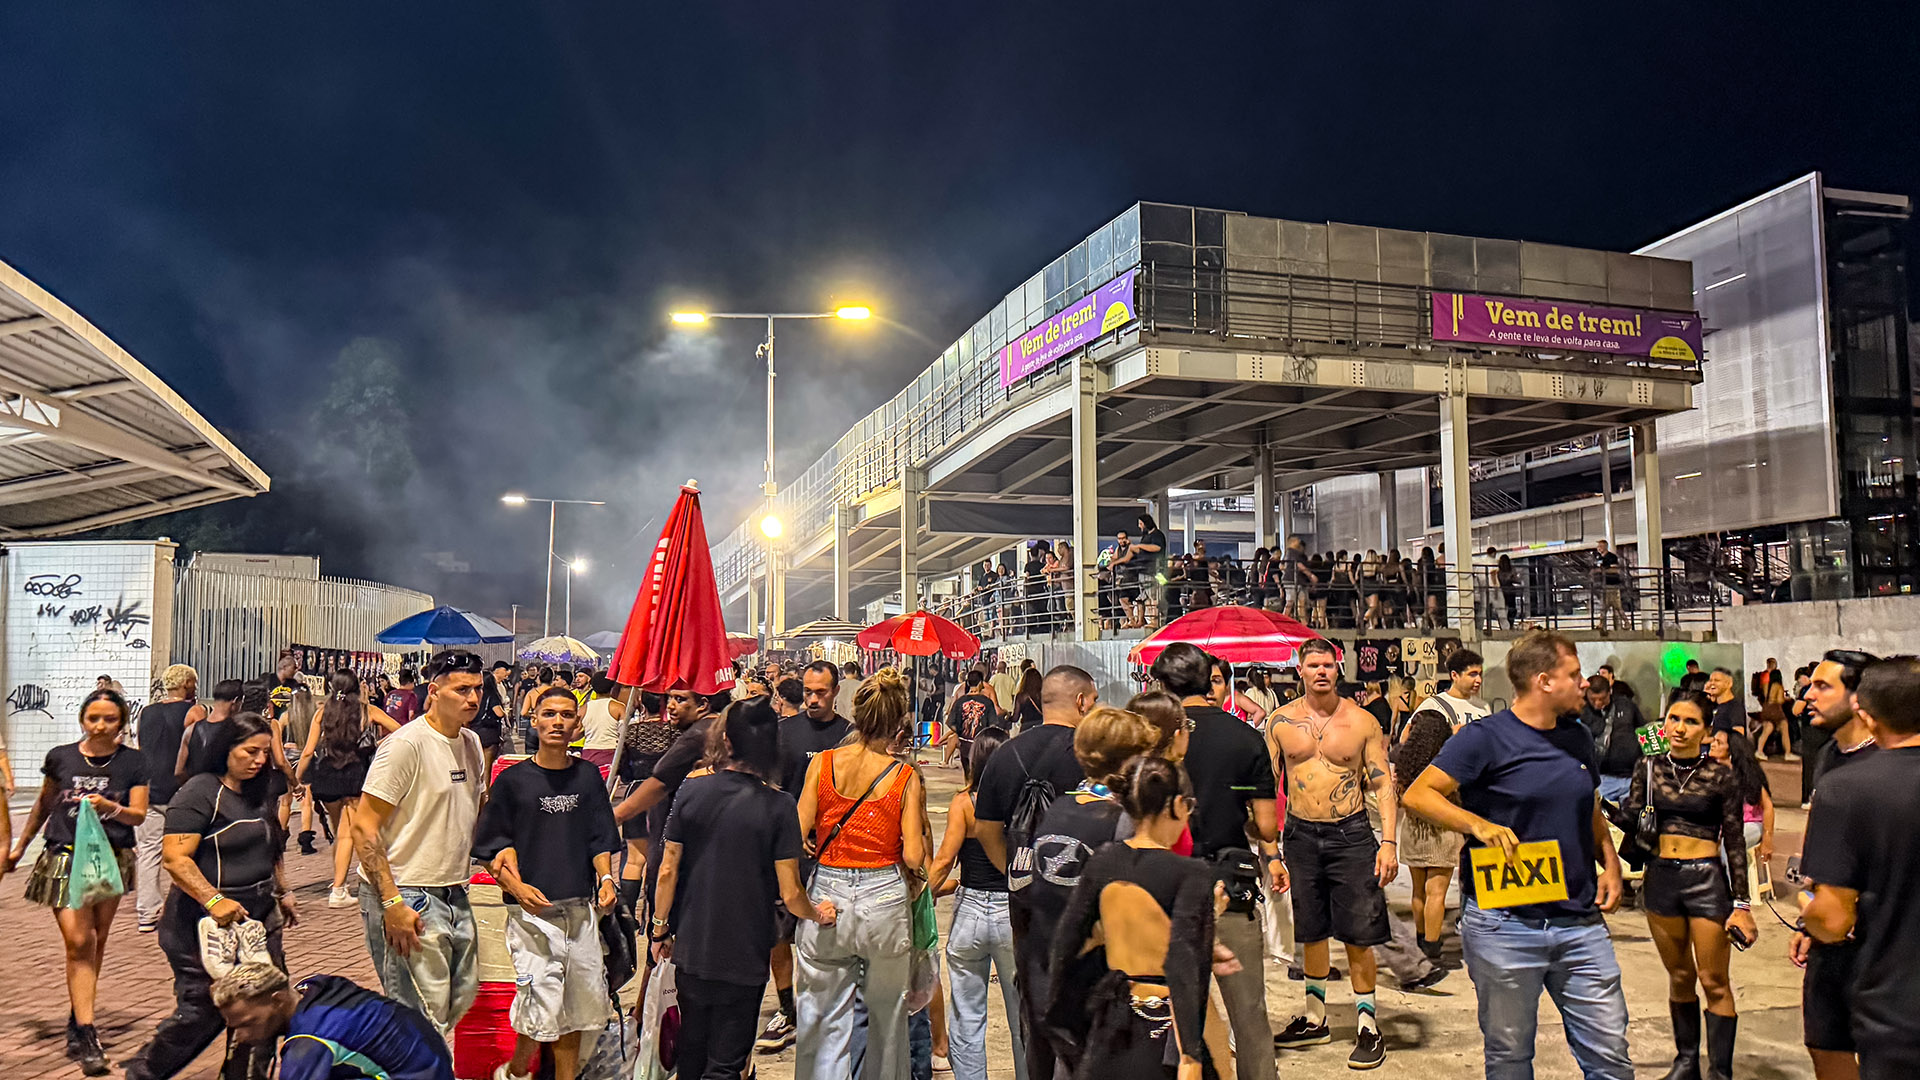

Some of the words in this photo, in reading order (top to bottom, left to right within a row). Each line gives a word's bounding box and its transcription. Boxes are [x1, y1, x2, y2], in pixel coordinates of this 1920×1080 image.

[1020, 333, 1044, 359] Vem
[1045, 320, 1060, 344] de
[1061, 294, 1097, 335] trem!
[1484, 301, 1541, 328] Vem
[1545, 306, 1574, 331] de
[1577, 311, 1641, 337] trem!
[1489, 329, 1496, 339] A
[1497, 331, 1521, 341] gente
[1523, 332, 1532, 342] te
[1533, 332, 1550, 343] leva
[1551, 334, 1562, 344] de
[1563, 335, 1582, 346] volta
[1583, 338, 1601, 348] para
[1476, 856, 1561, 891] TAXI
